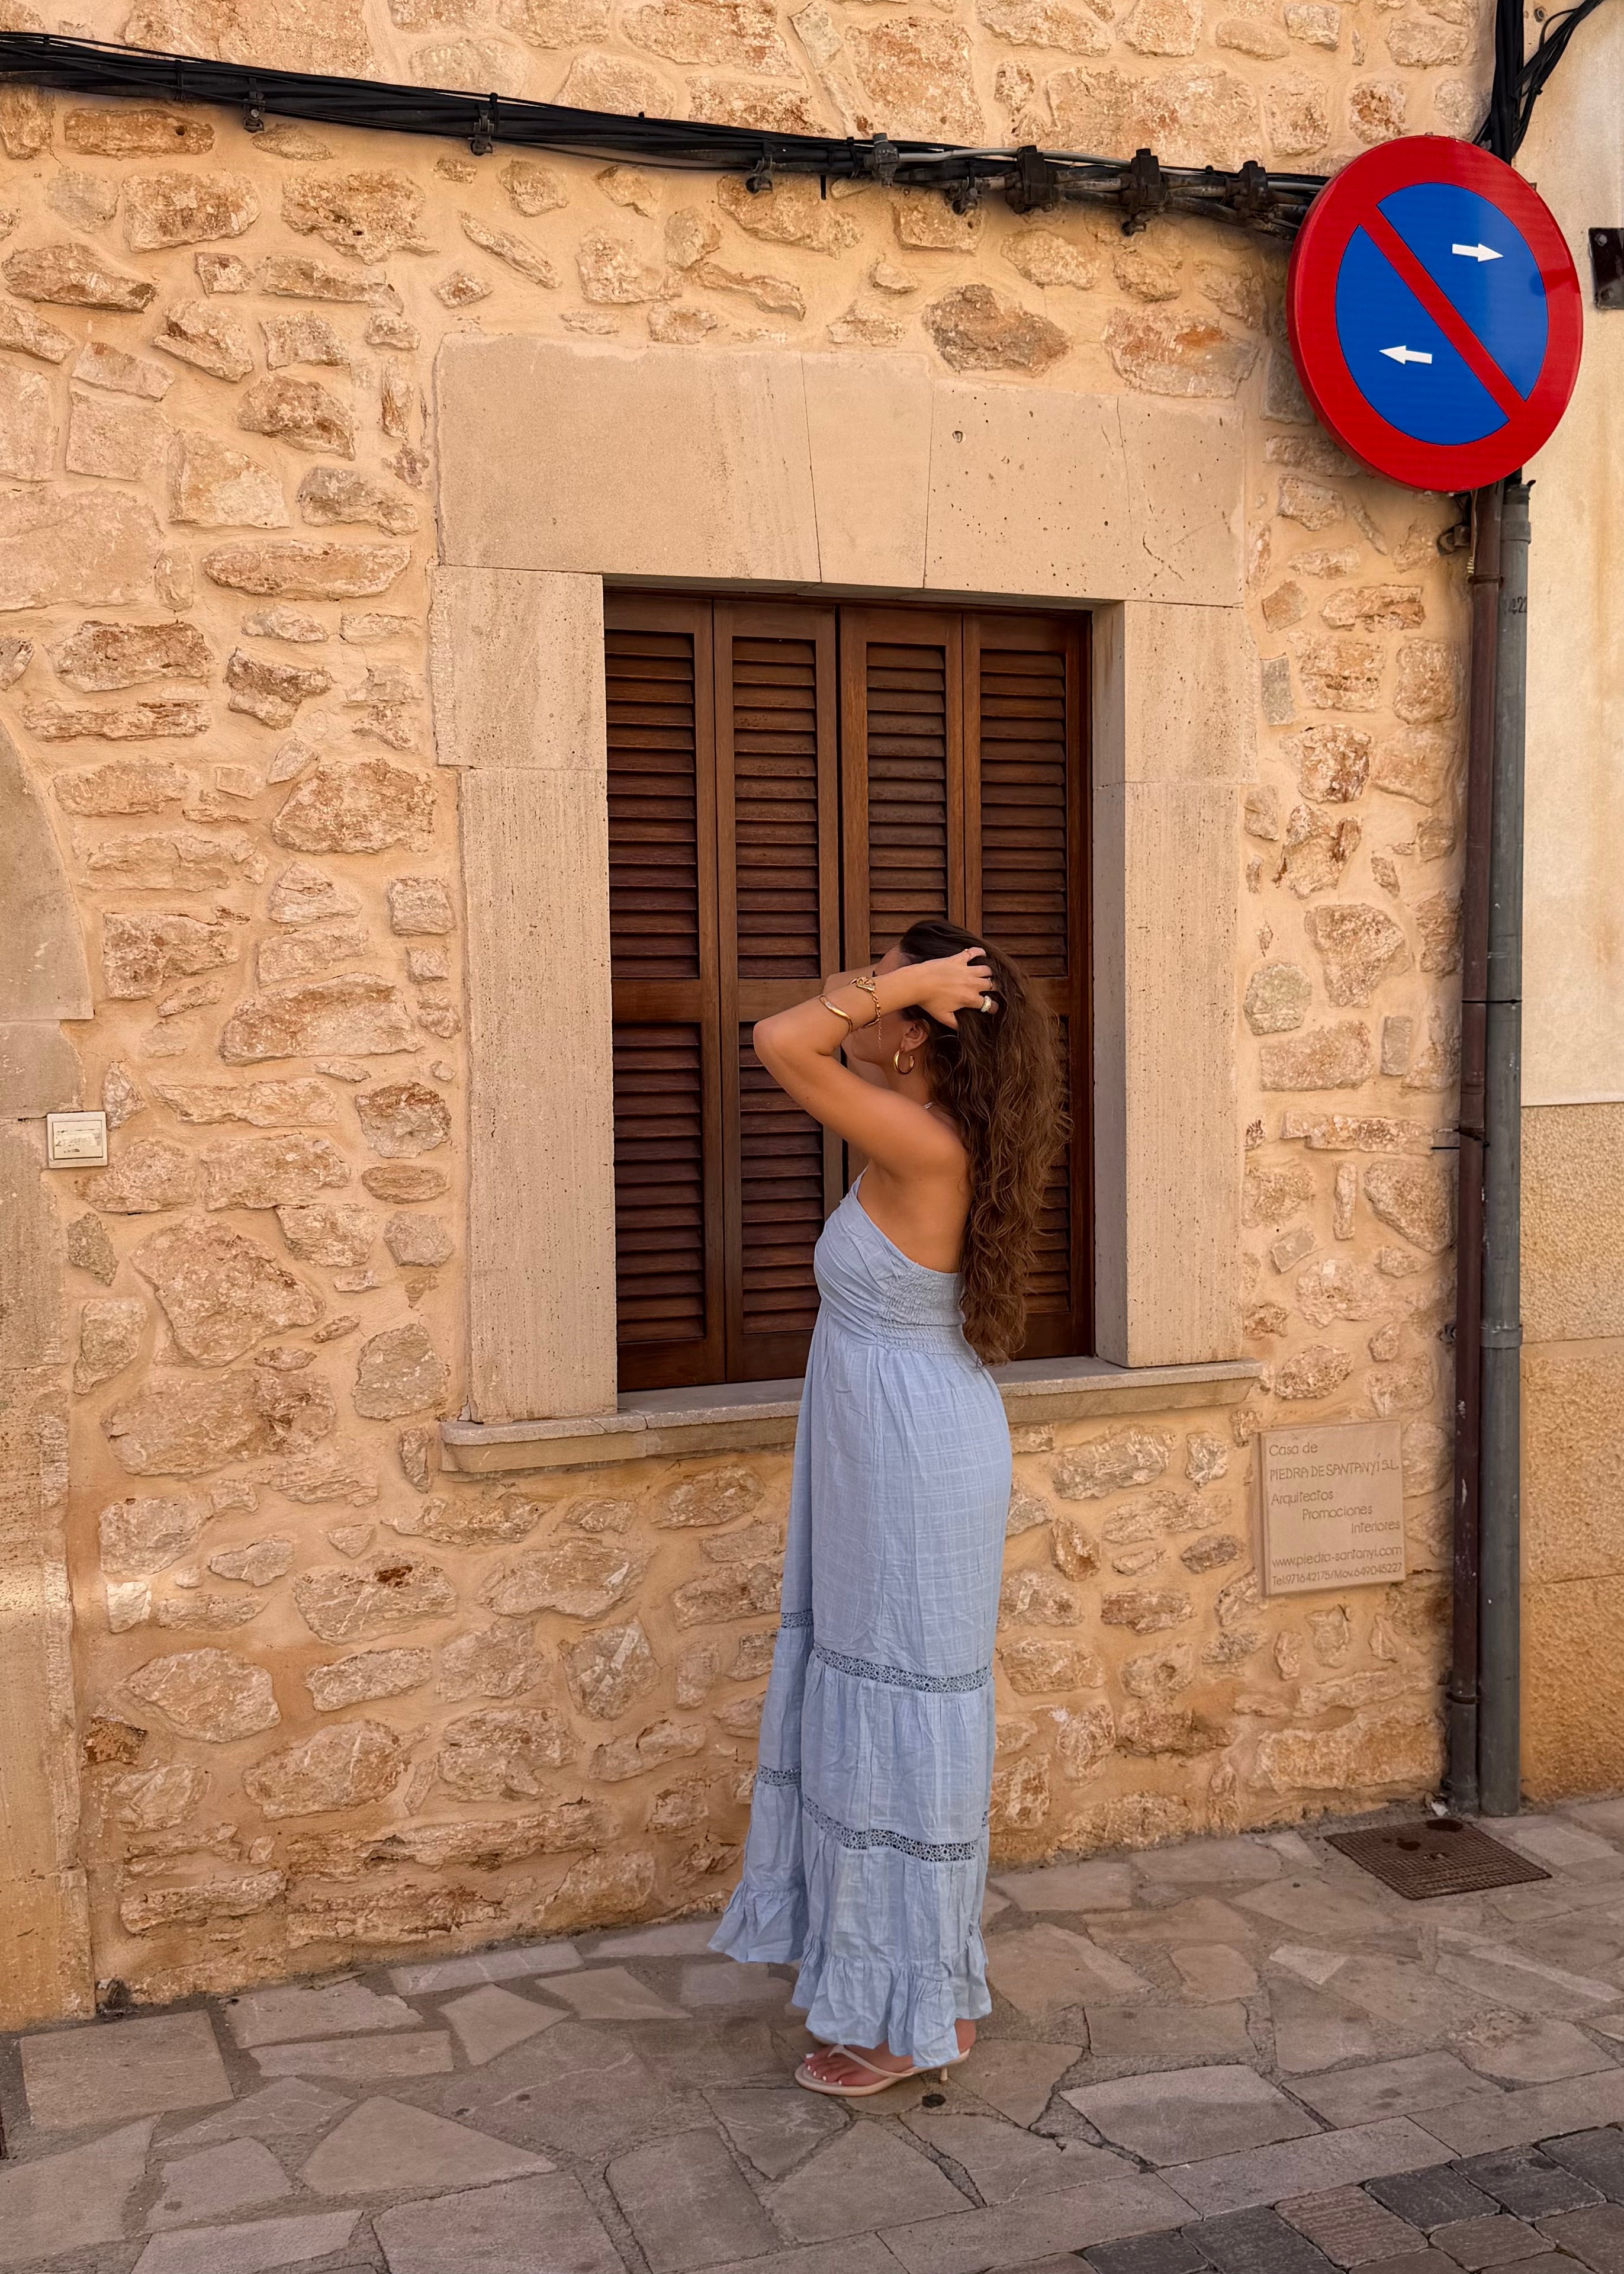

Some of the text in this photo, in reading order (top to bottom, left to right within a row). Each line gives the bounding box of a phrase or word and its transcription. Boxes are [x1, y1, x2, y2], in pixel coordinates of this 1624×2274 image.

[1269, 1442, 1318, 1456] Casa de
[1270, 1467, 1309, 1481] PIEDRA
[1311, 1465, 1324, 1478] DE
[1271, 1490, 1333, 1506] Arquitectos
[1303, 1505, 1373, 1521] Promociones
[1351, 1520, 1401, 1534] Interiores
[1272, 1545, 1402, 1568] www.piedra-santanyi.com
